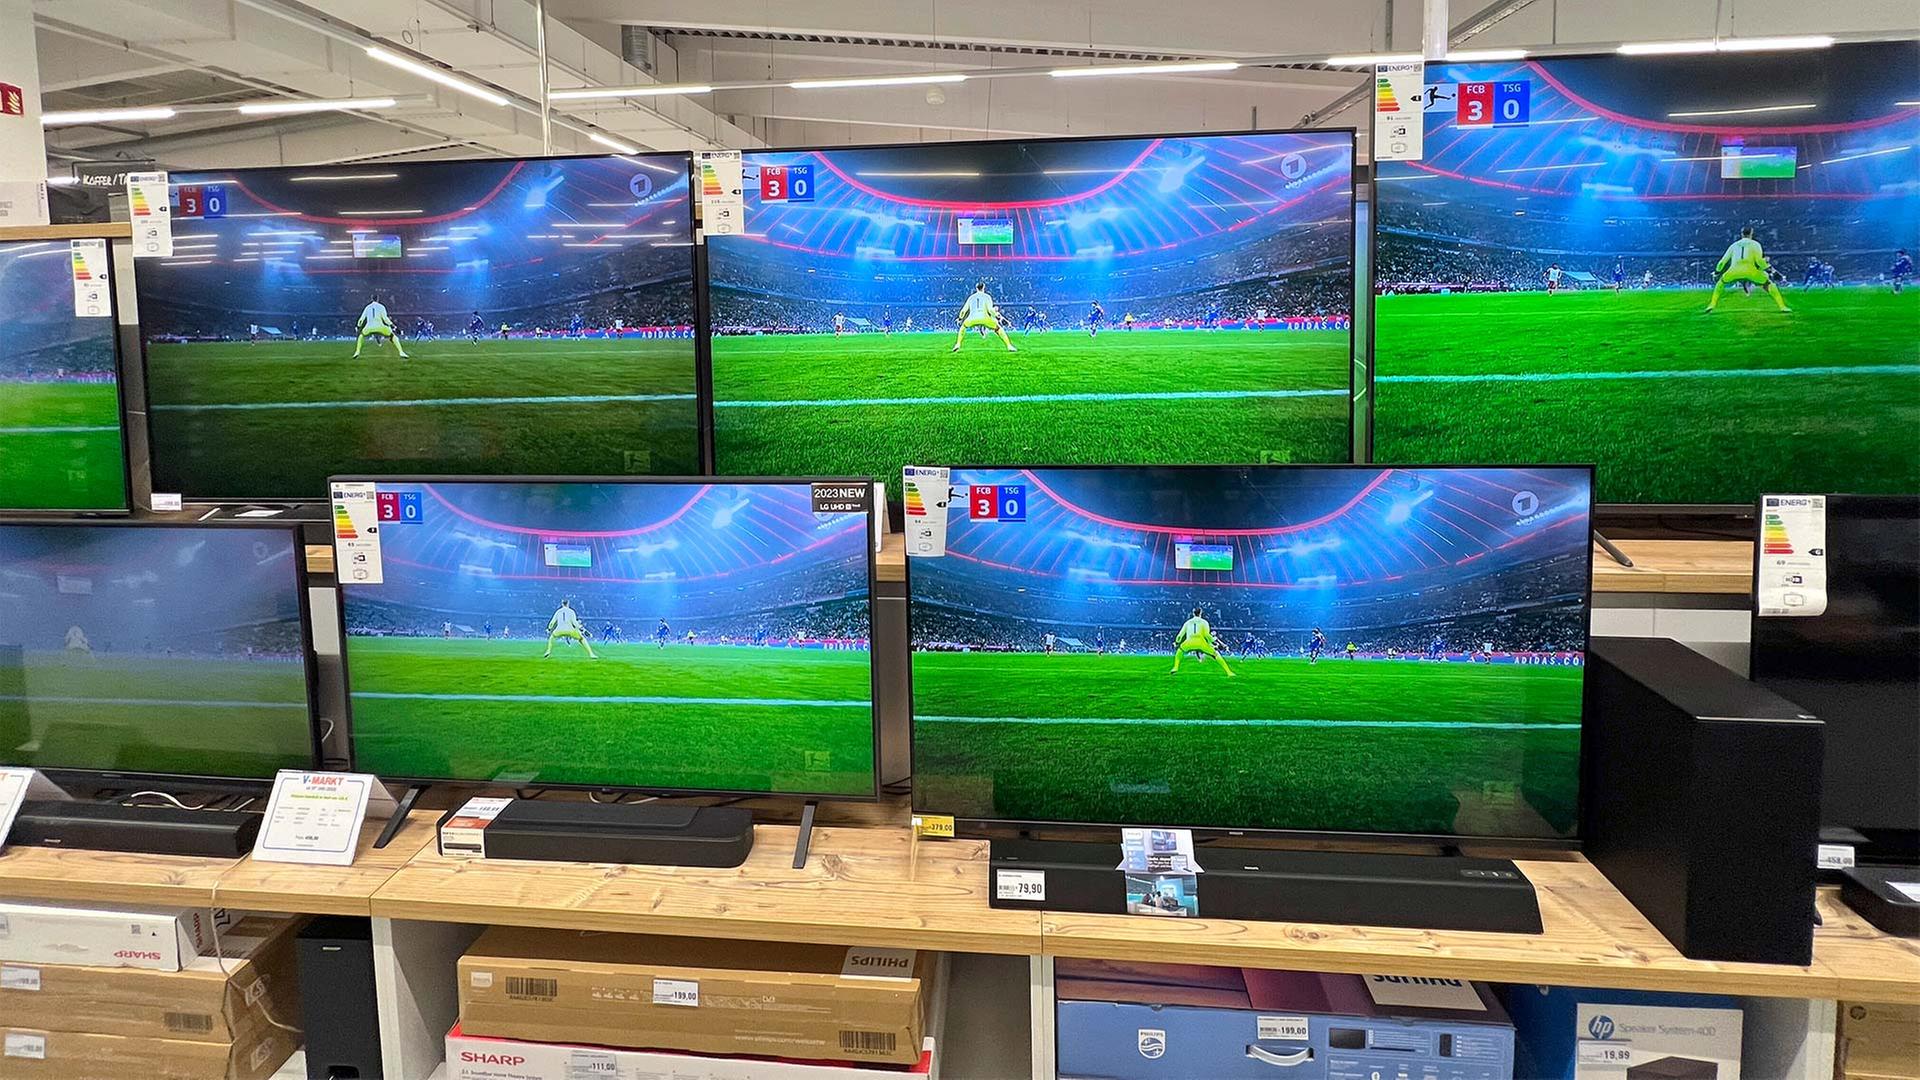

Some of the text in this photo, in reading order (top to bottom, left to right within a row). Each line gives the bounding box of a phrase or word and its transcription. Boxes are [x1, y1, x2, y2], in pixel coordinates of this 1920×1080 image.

[1466, 85, 1485, 94] FCB
[1503, 84, 1521, 93] TSG
[1467, 100, 1483, 121] 3
[1503, 99, 1520, 120] 0
[766, 167, 781, 175] FCB
[768, 180, 780, 197] 3
[794, 180, 807, 196] 0
[186, 198, 197, 213] 3
[209, 197, 220, 212] 0
[1287, 321, 1351, 330] ADIDAS.CO
[915, 468, 936, 476] ENERG
[814, 488, 866, 498] 2023 NEW
[383, 505, 393, 518] 3
[405, 505, 416, 519] 0
[977, 499, 990, 516] 3
[1005, 499, 1019, 516] 0
[1018, 883, 1043, 894] 79,90
[113, 950, 161, 960] SHARP
[850, 956, 909, 968] PHILIPS
[1280, 1026, 1307, 1036] 199,00
[1592, 1016, 1612, 1038] hp
[461, 1051, 526, 1066] SHARP
